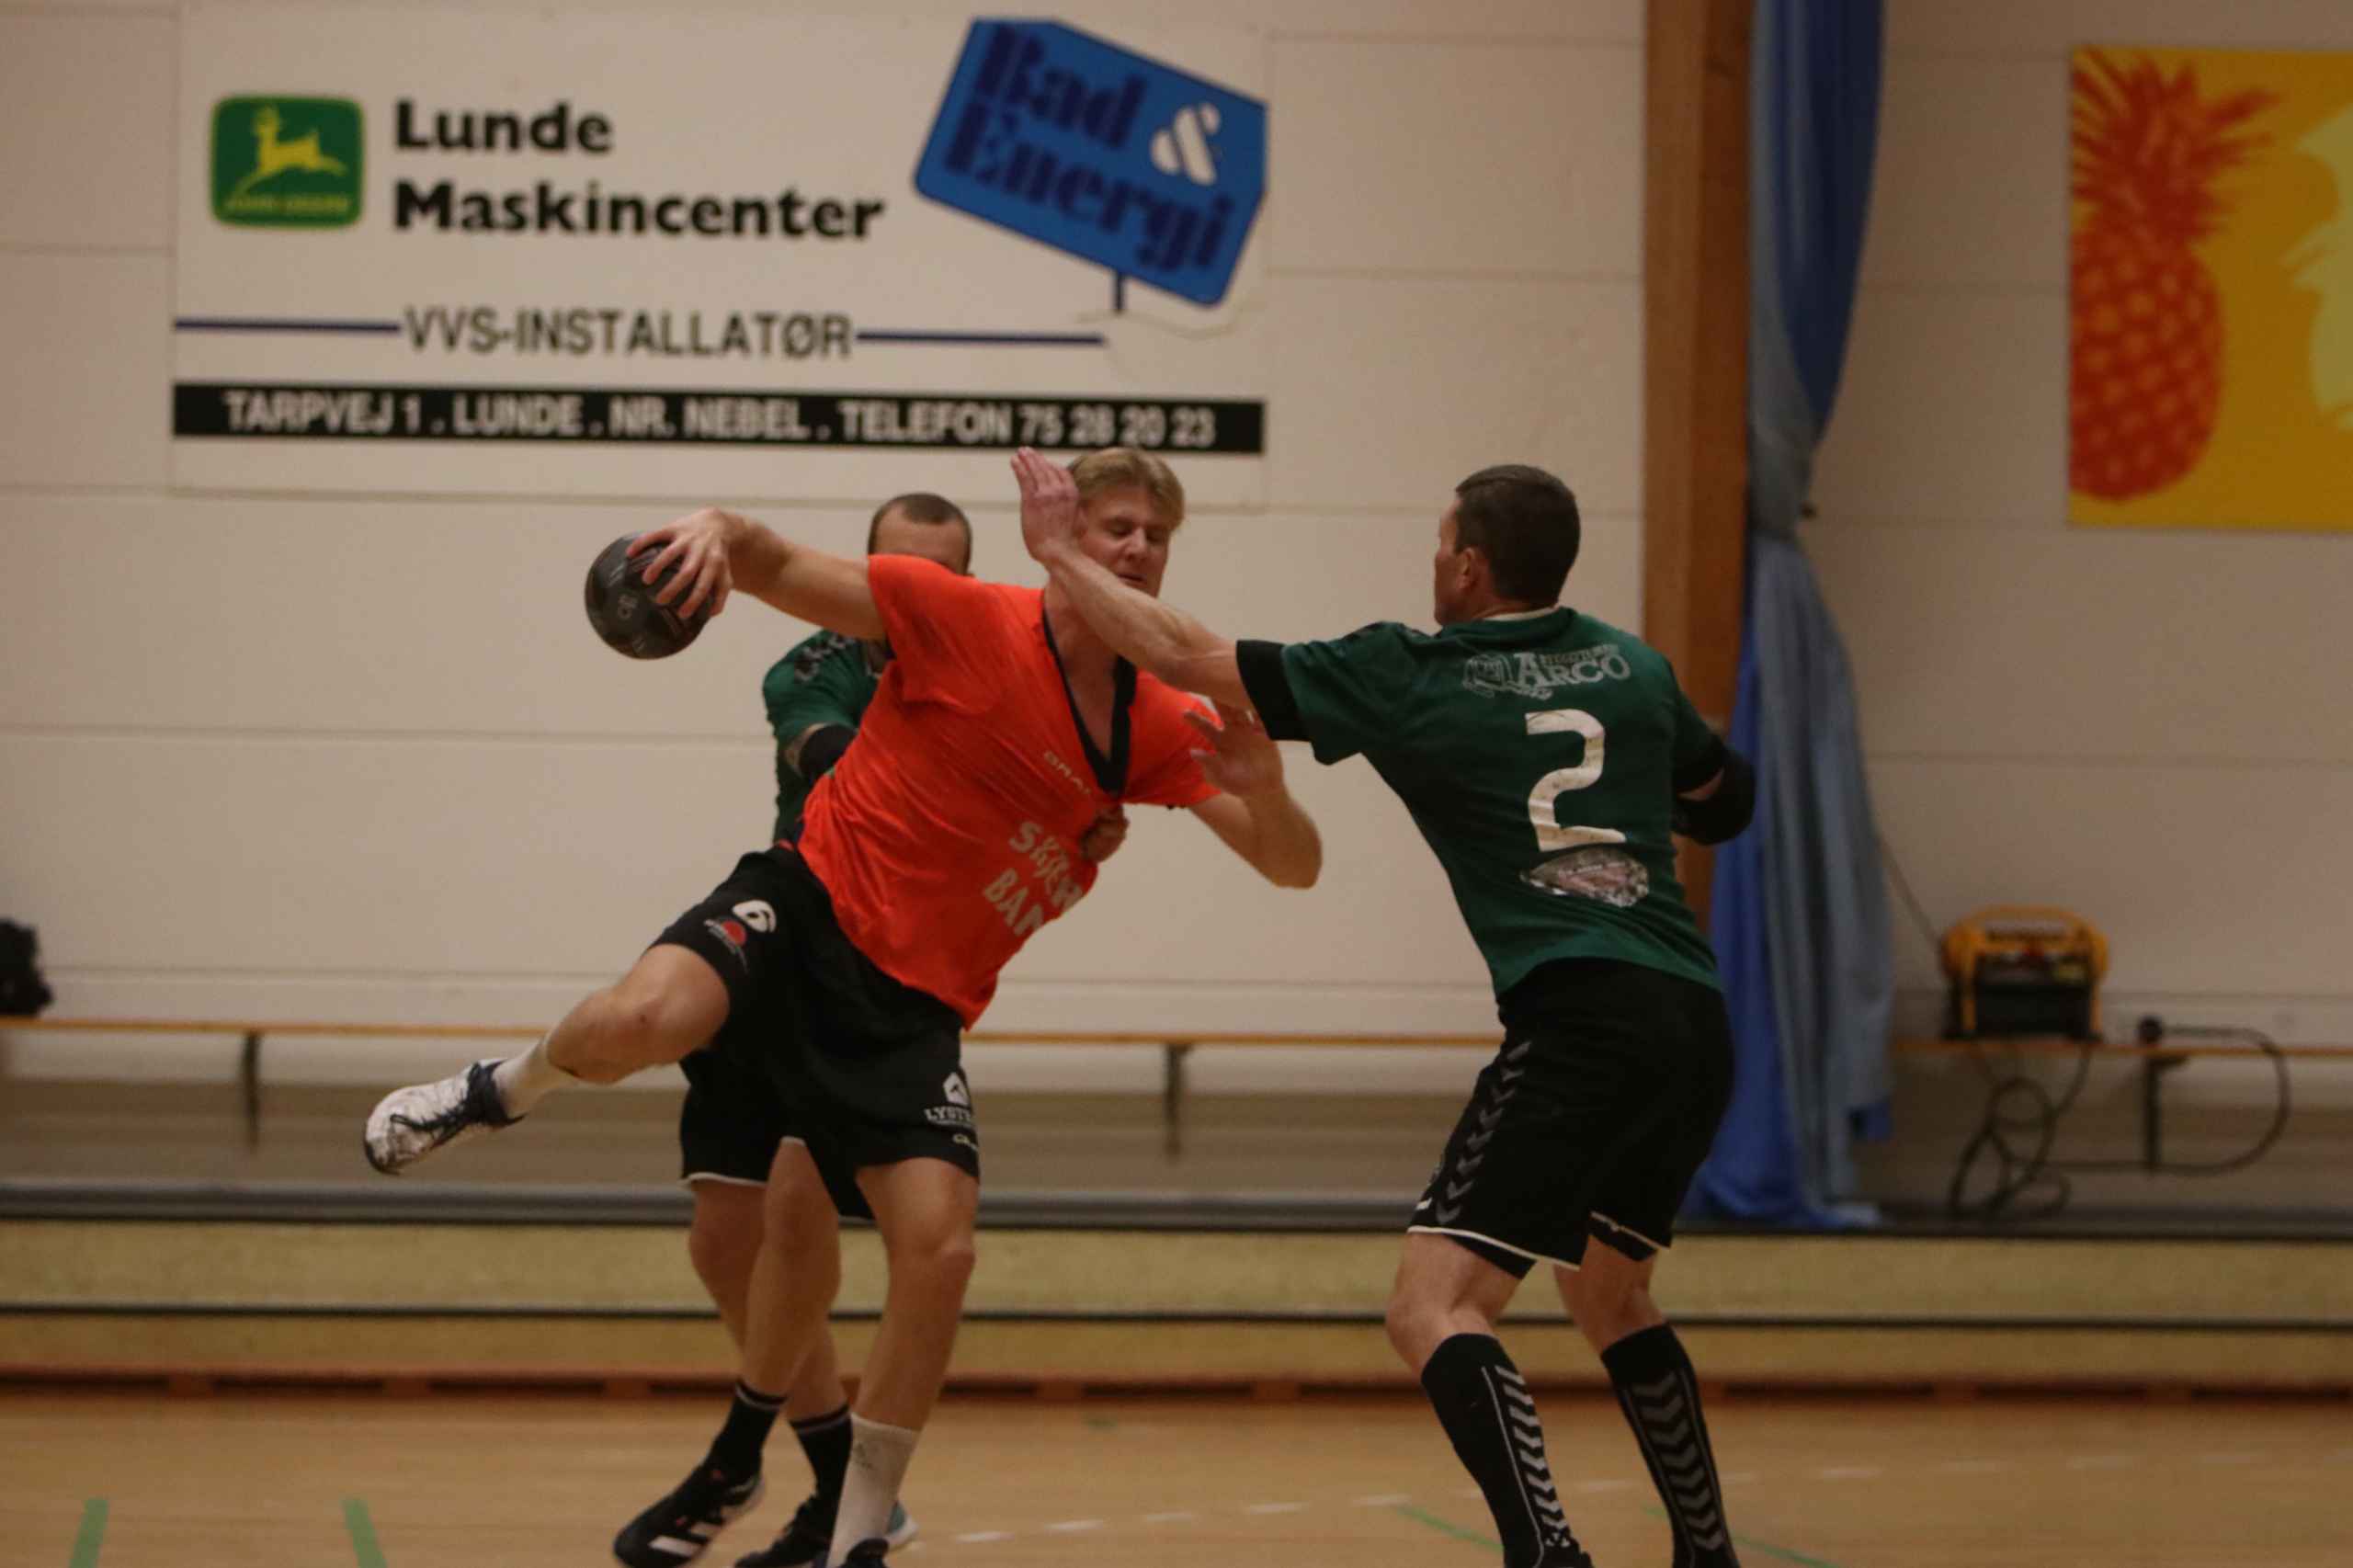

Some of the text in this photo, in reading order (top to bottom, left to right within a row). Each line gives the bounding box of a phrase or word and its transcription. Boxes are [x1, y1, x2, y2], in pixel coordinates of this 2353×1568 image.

[393, 98, 612, 155] Lunde
[972, 25, 1221, 186] Bad &
[393, 177, 886, 240] Maskincenter
[941, 98, 1235, 272] Energi
[403, 305, 855, 359] VVS-INSTALLATØR
[452, 395, 583, 437] LUNDE
[683, 398, 810, 439] NEBEL
[838, 400, 1013, 442] TELEFON
[1019, 404, 1063, 445] 75
[1523, 708, 1627, 852] 2
